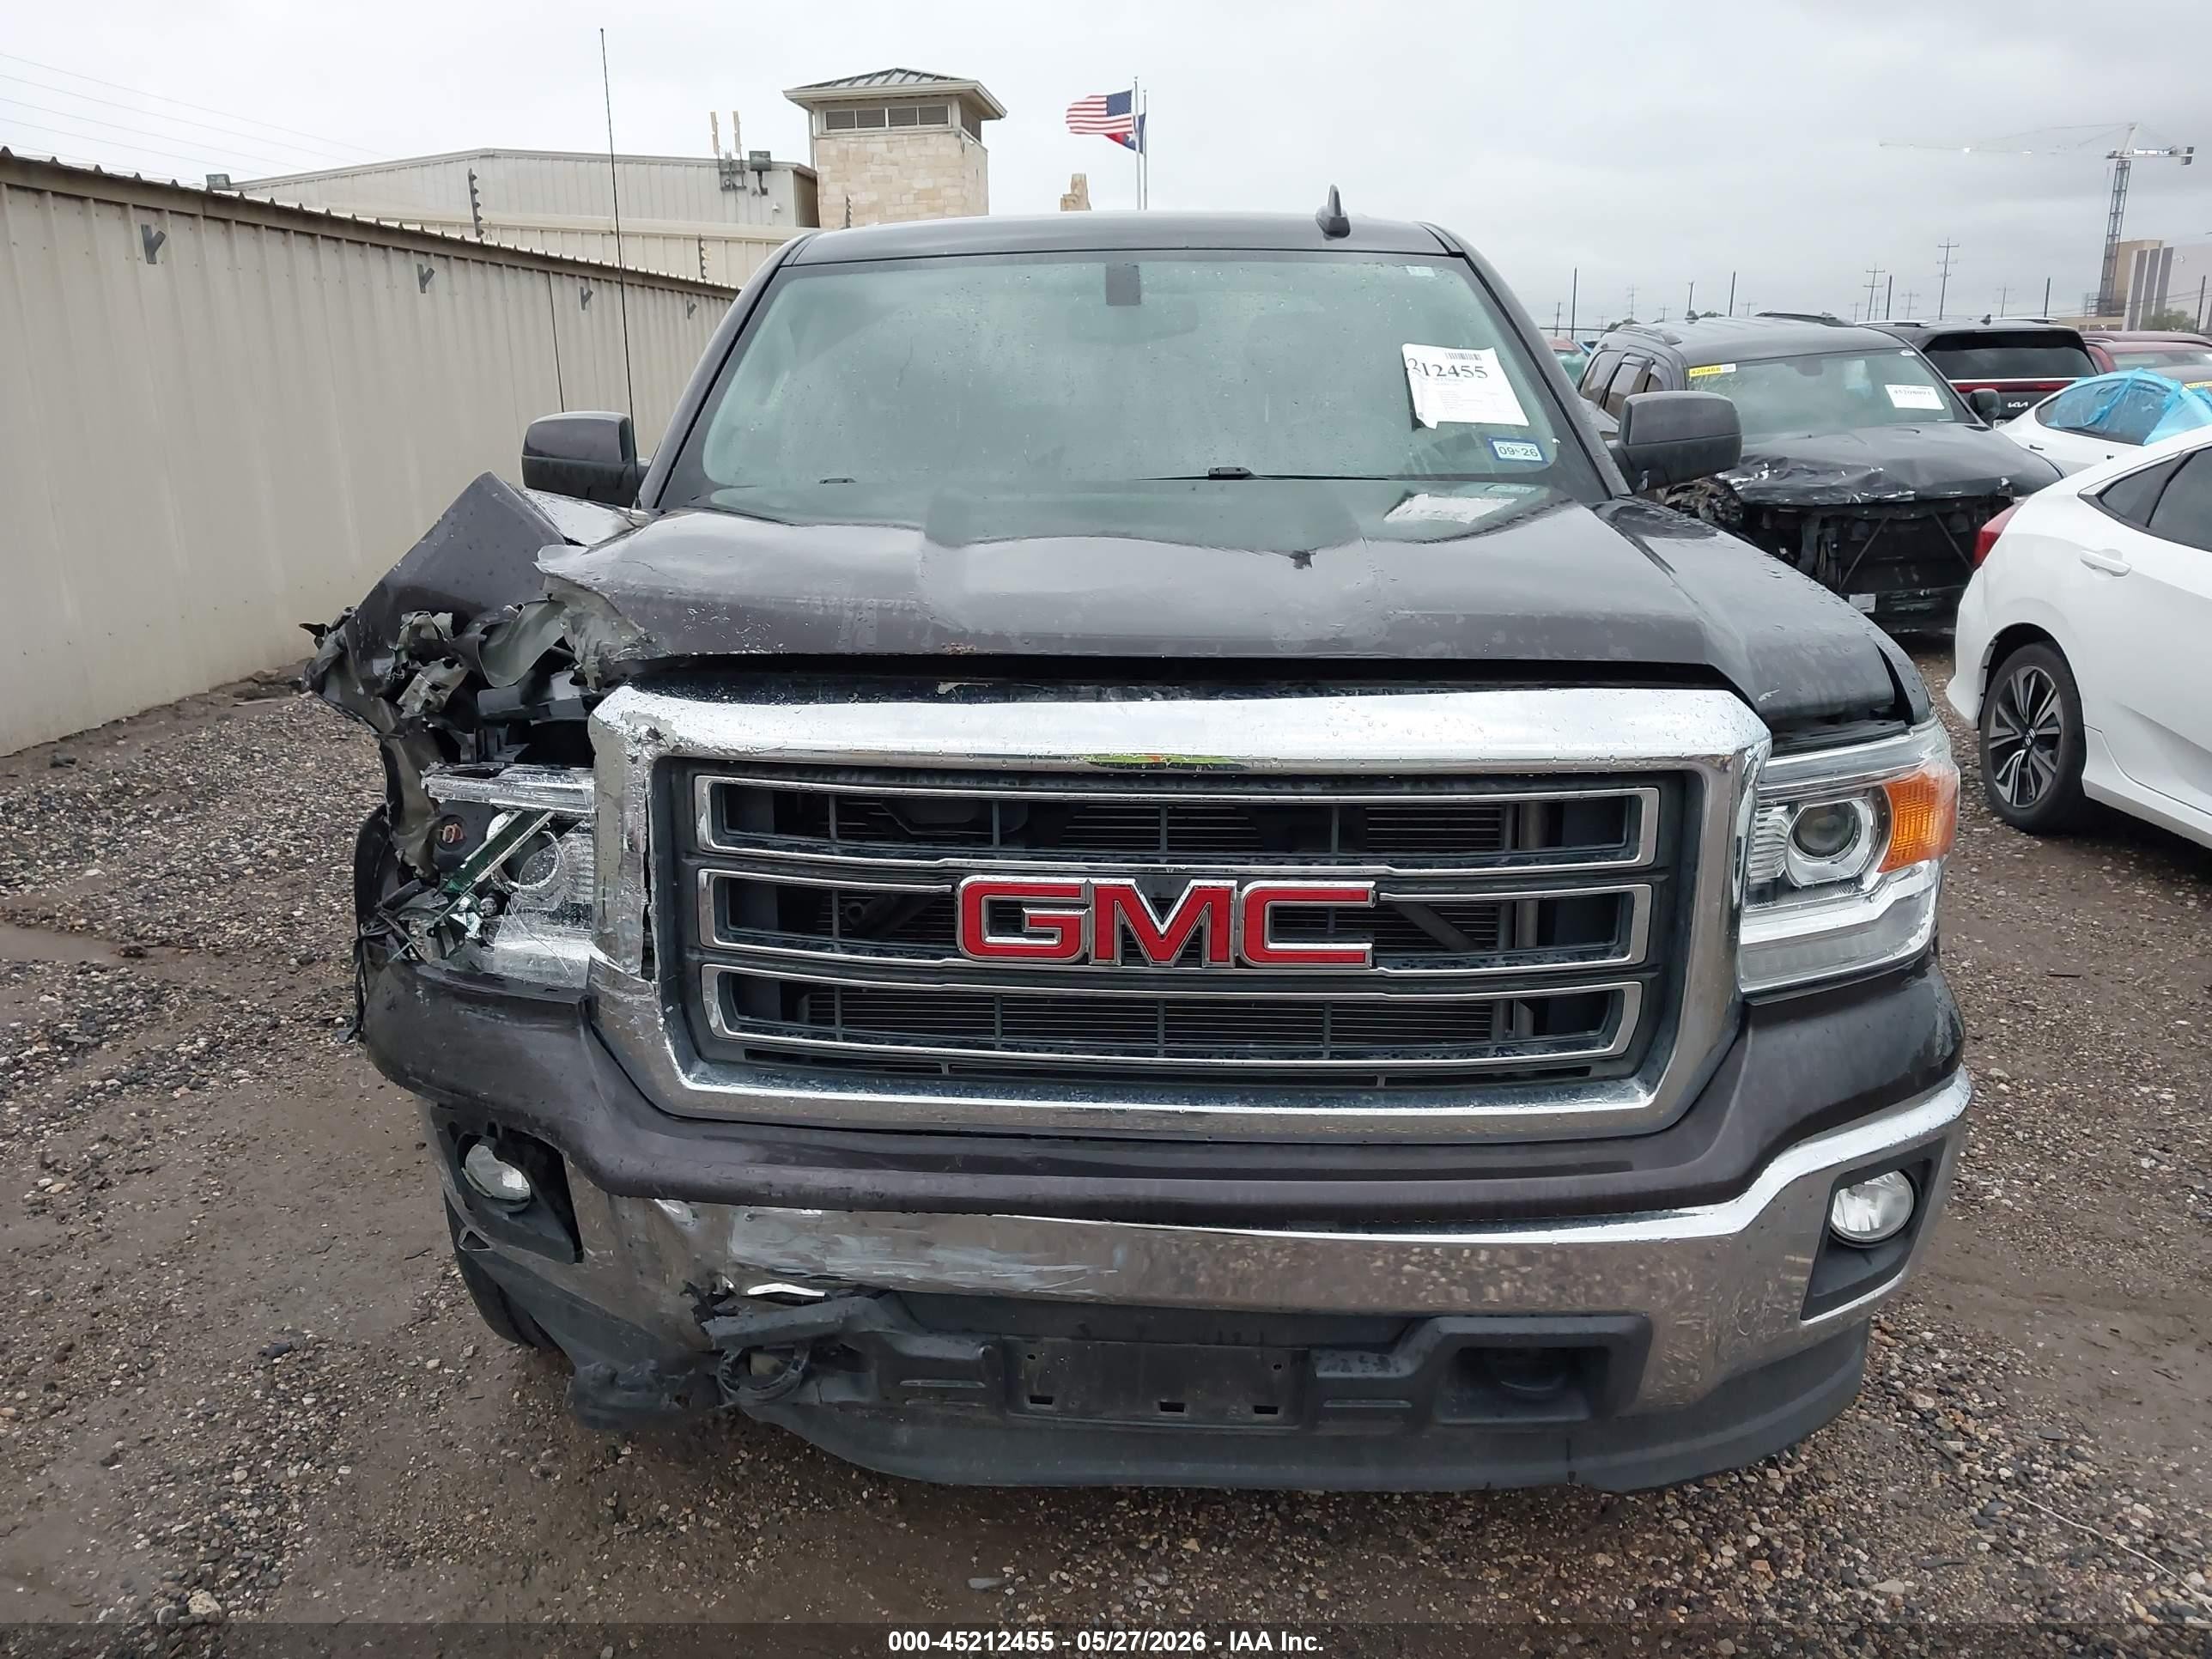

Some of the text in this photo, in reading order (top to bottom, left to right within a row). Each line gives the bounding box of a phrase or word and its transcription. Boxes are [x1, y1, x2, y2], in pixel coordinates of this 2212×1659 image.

[1498, 446, 1539, 457] 09 26
[957, 875, 1376, 969] GMC
